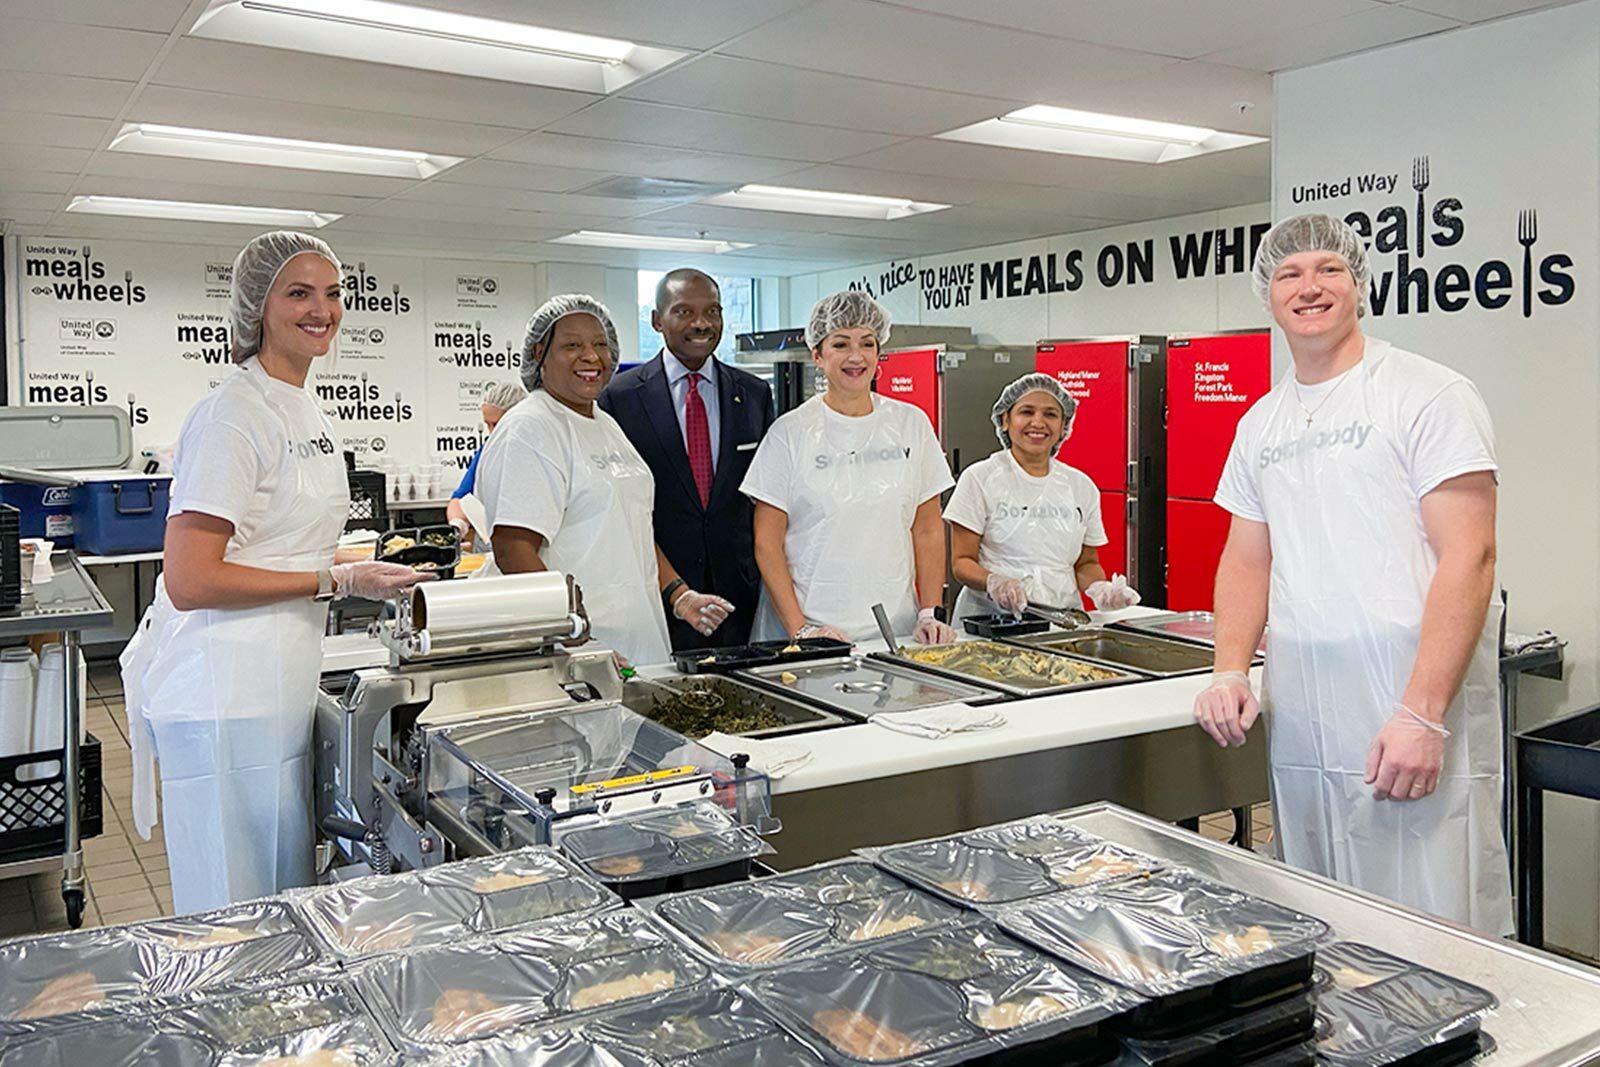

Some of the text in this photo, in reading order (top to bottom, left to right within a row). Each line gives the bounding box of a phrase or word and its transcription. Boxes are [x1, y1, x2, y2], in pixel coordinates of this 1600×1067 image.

[1292, 173, 1399, 204] United Way
[1342, 165, 1465, 258] eals
[26, 245, 77, 256] United Way
[26, 248, 105, 281] meals
[919, 263, 975, 290] TO HAVE
[980, 249, 1084, 301] MEALS
[1097, 239, 1155, 288] ON
[53, 273, 146, 305] wheels
[880, 261, 917, 295] nice
[924, 285, 971, 310] YOU AT
[61, 320, 91, 340] United Way
[206, 314, 224, 322] Way
[458, 322, 472, 330] Way
[351, 336, 366, 345] Way
[435, 324, 492, 350] meals
[454, 343, 521, 370] wheels
[1205, 361, 1229, 372] Francis
[60, 373, 80, 381] Way
[1194, 372, 1225, 383] Kingston
[1194, 382, 1233, 392] Forest Park
[337, 394, 412, 422] wheels
[1194, 392, 1248, 402] Freedom Manor
